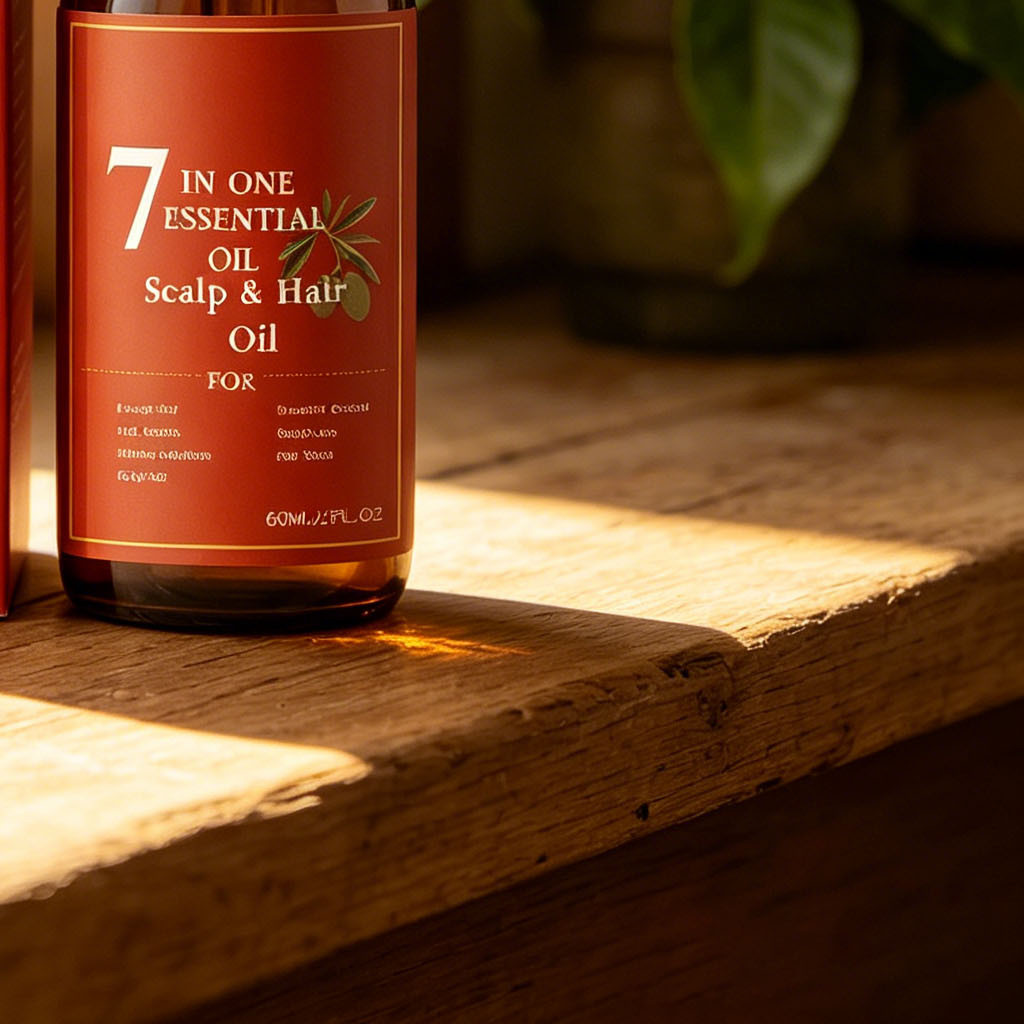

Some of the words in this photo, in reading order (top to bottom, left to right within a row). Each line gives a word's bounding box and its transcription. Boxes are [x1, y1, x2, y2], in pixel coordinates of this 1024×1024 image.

[106, 145, 170, 250] 7
[179, 169, 216, 195] IN
[228, 170, 295, 196] ONE
[163, 206, 326, 232] ESSENTIAL
[208, 246, 260, 273] OIL
[144, 276, 227, 315] Scalp
[240, 279, 263, 305] &
[228, 323, 279, 353] Oil
[207, 371, 257, 391] FOR
